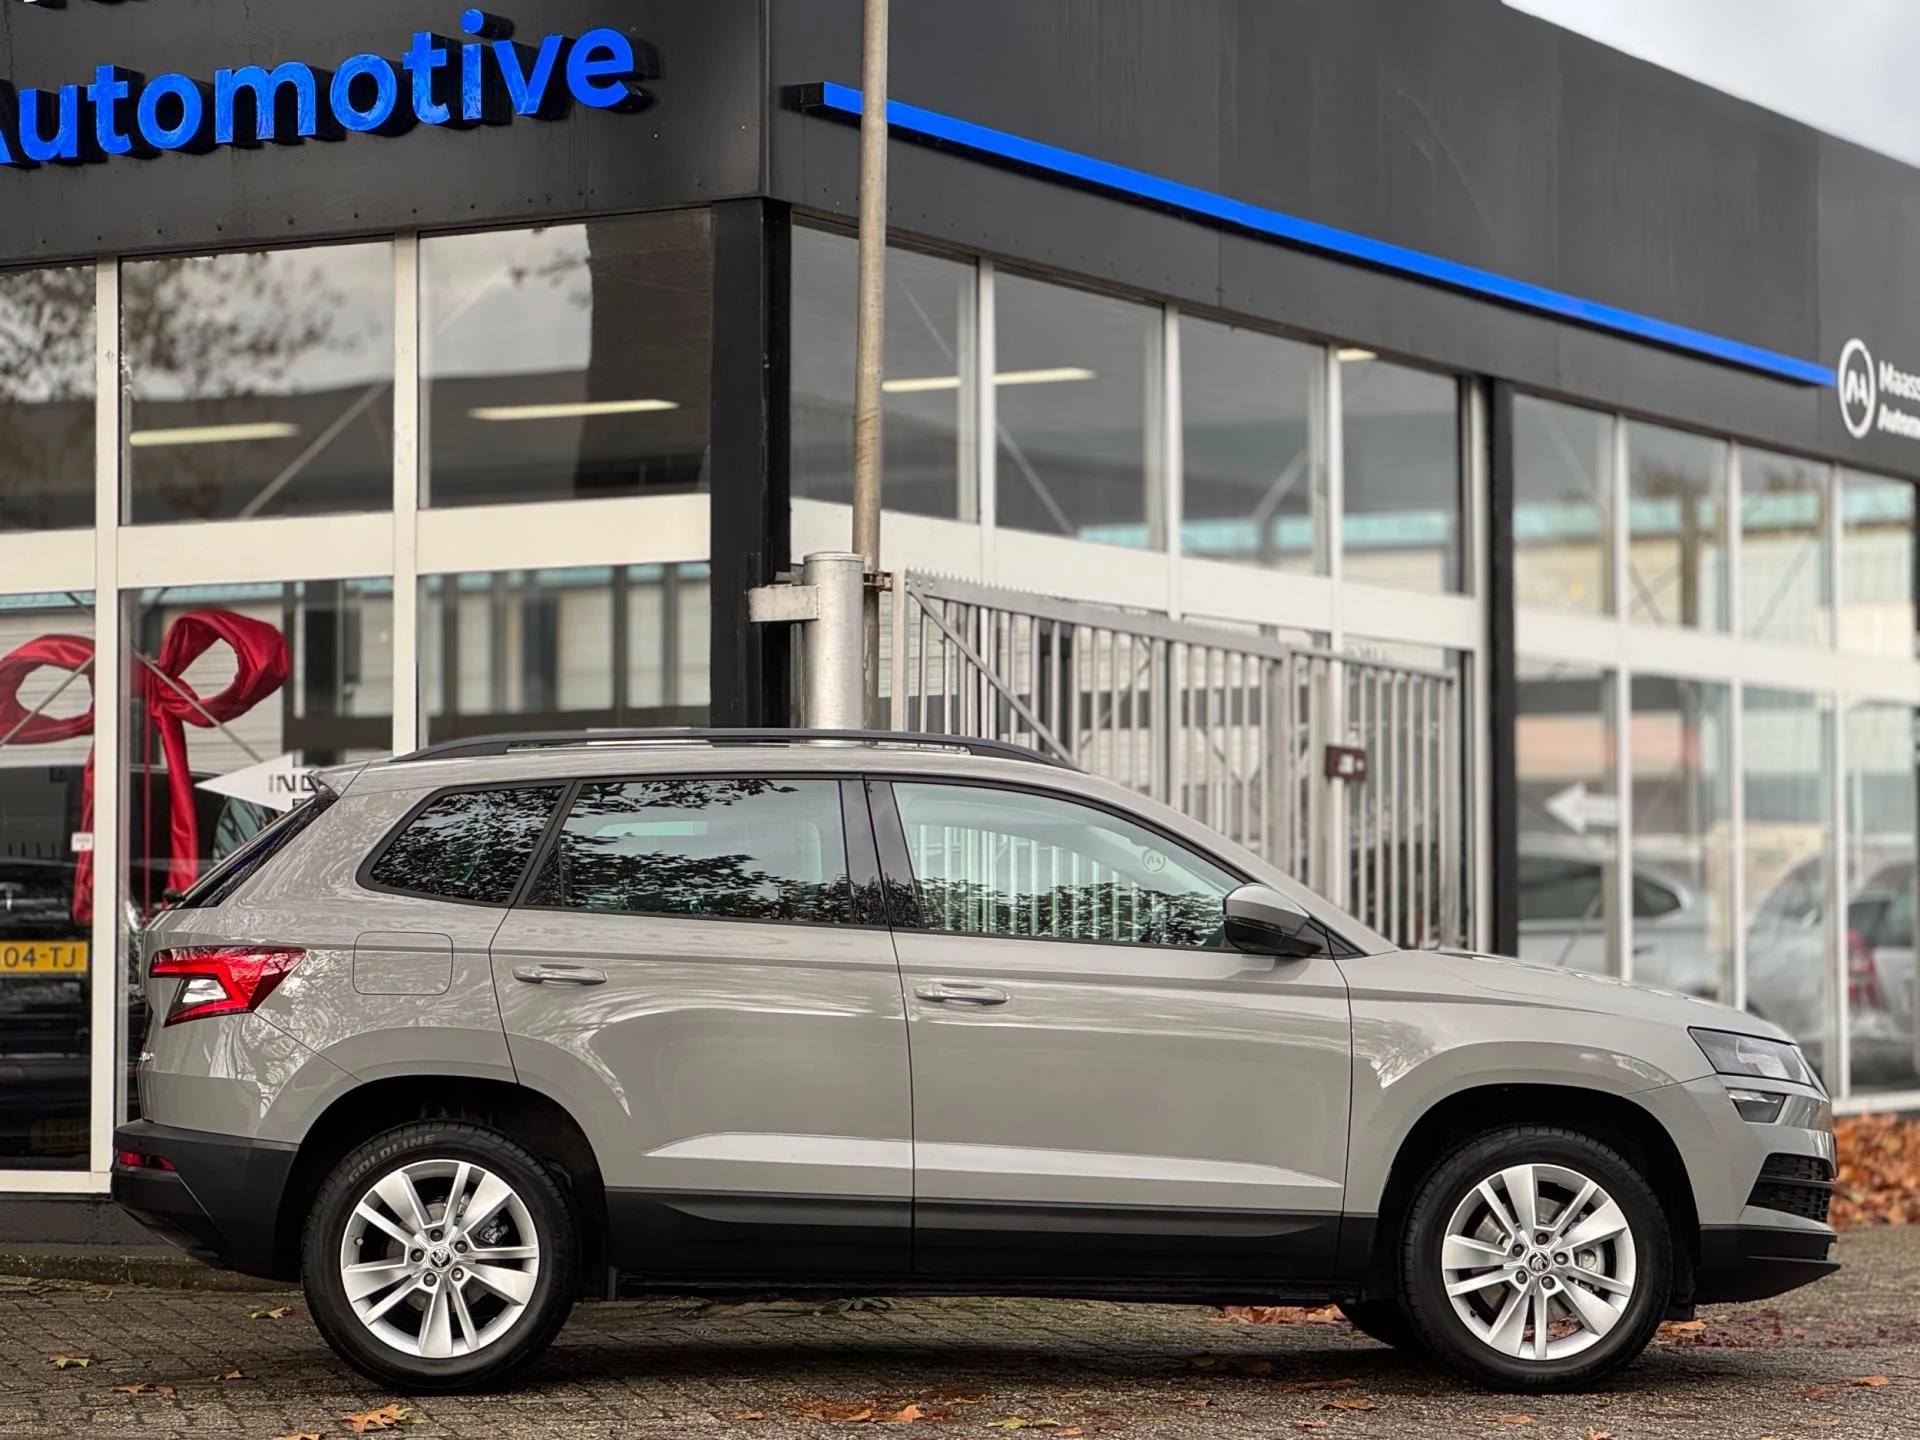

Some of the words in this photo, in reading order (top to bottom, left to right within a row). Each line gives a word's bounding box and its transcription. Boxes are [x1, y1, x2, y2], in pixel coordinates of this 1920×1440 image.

[0, 8, 634, 163] utomotive
[4, 946, 76, 969] 04-TJ
[348, 1134, 435, 1184] GOLDLINE
